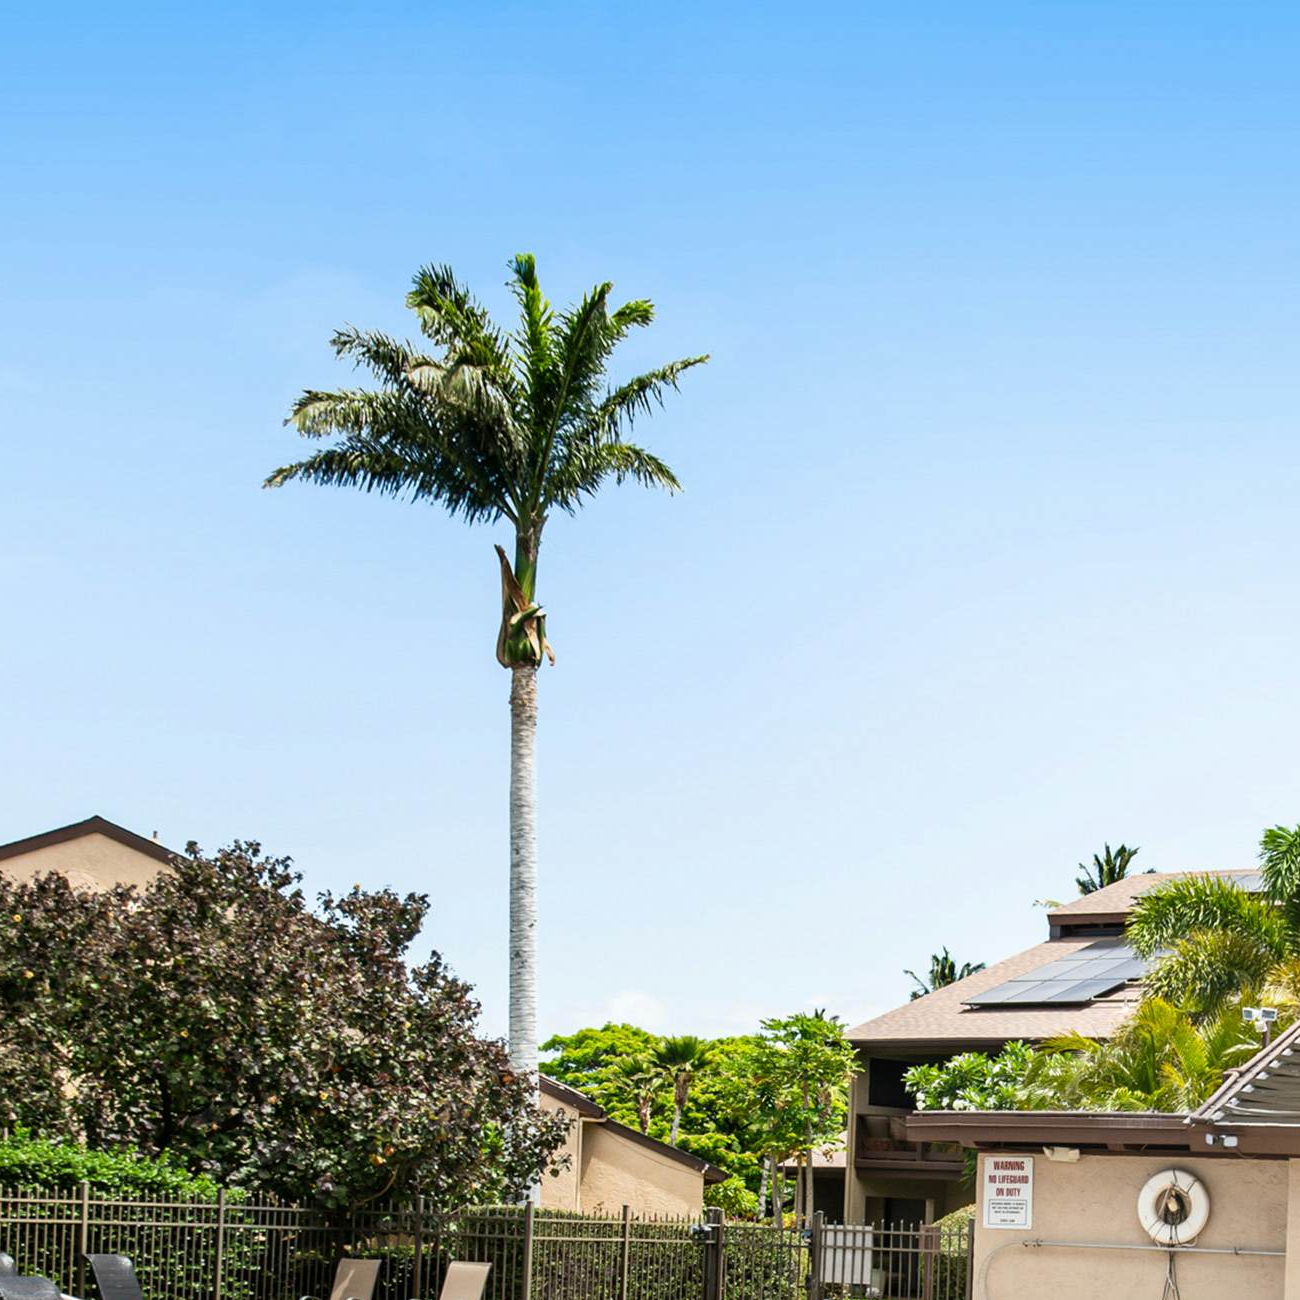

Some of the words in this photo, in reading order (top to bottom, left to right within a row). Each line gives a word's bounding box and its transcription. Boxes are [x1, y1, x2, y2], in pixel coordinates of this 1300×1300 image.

[993, 1160, 1025, 1171] WARNING
[988, 1174, 997, 1184] NO
[998, 1174, 1029, 1184] LIFEGUARD
[996, 1187, 1004, 1197] ON
[1006, 1187, 1021, 1197] DUTY
